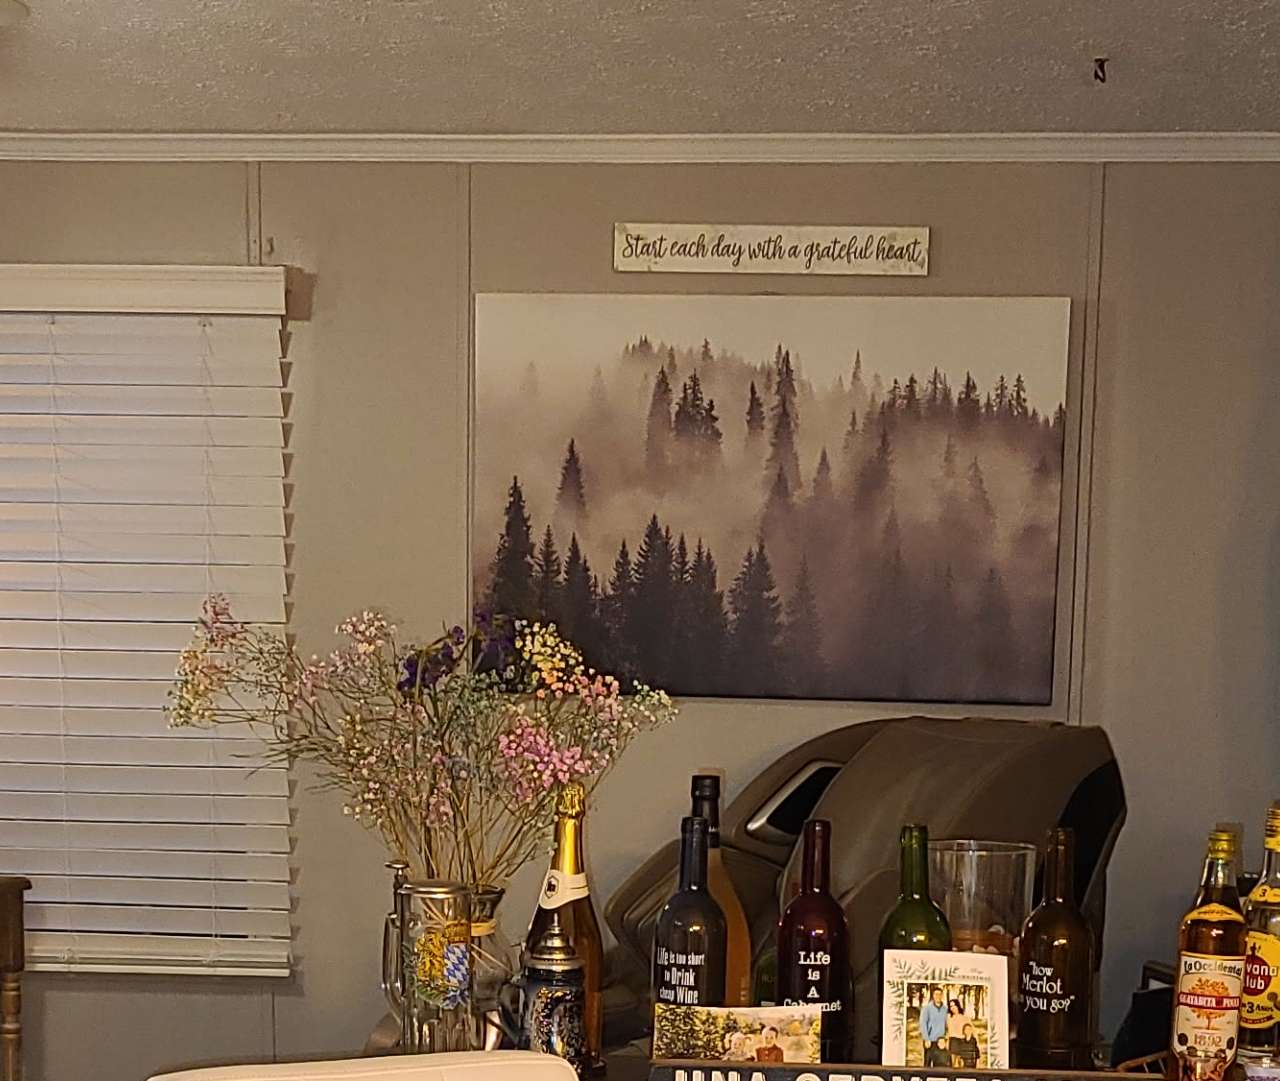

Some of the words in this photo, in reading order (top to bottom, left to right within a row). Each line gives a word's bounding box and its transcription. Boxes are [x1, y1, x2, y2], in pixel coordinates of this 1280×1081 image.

[622, 233, 667, 259] Start
[670, 233, 709, 258] each
[710, 233, 745, 267] day
[747, 235, 785, 260] with
[788, 242, 801, 259] a
[803, 234, 874, 269] grateful
[876, 235, 922, 262] heart
[656, 946, 669, 966] Life
[669, 950, 675, 964] is
[676, 952, 686, 965] too
[687, 951, 705, 966] short
[798, 951, 831, 965] Life
[671, 967, 696, 986] Drink
[807, 968, 820, 980] is
[1022, 972, 1064, 995] Merlot
[676, 985, 699, 1004] Wine
[807, 986, 820, 998] A
[1024, 995, 1047, 1012] you
